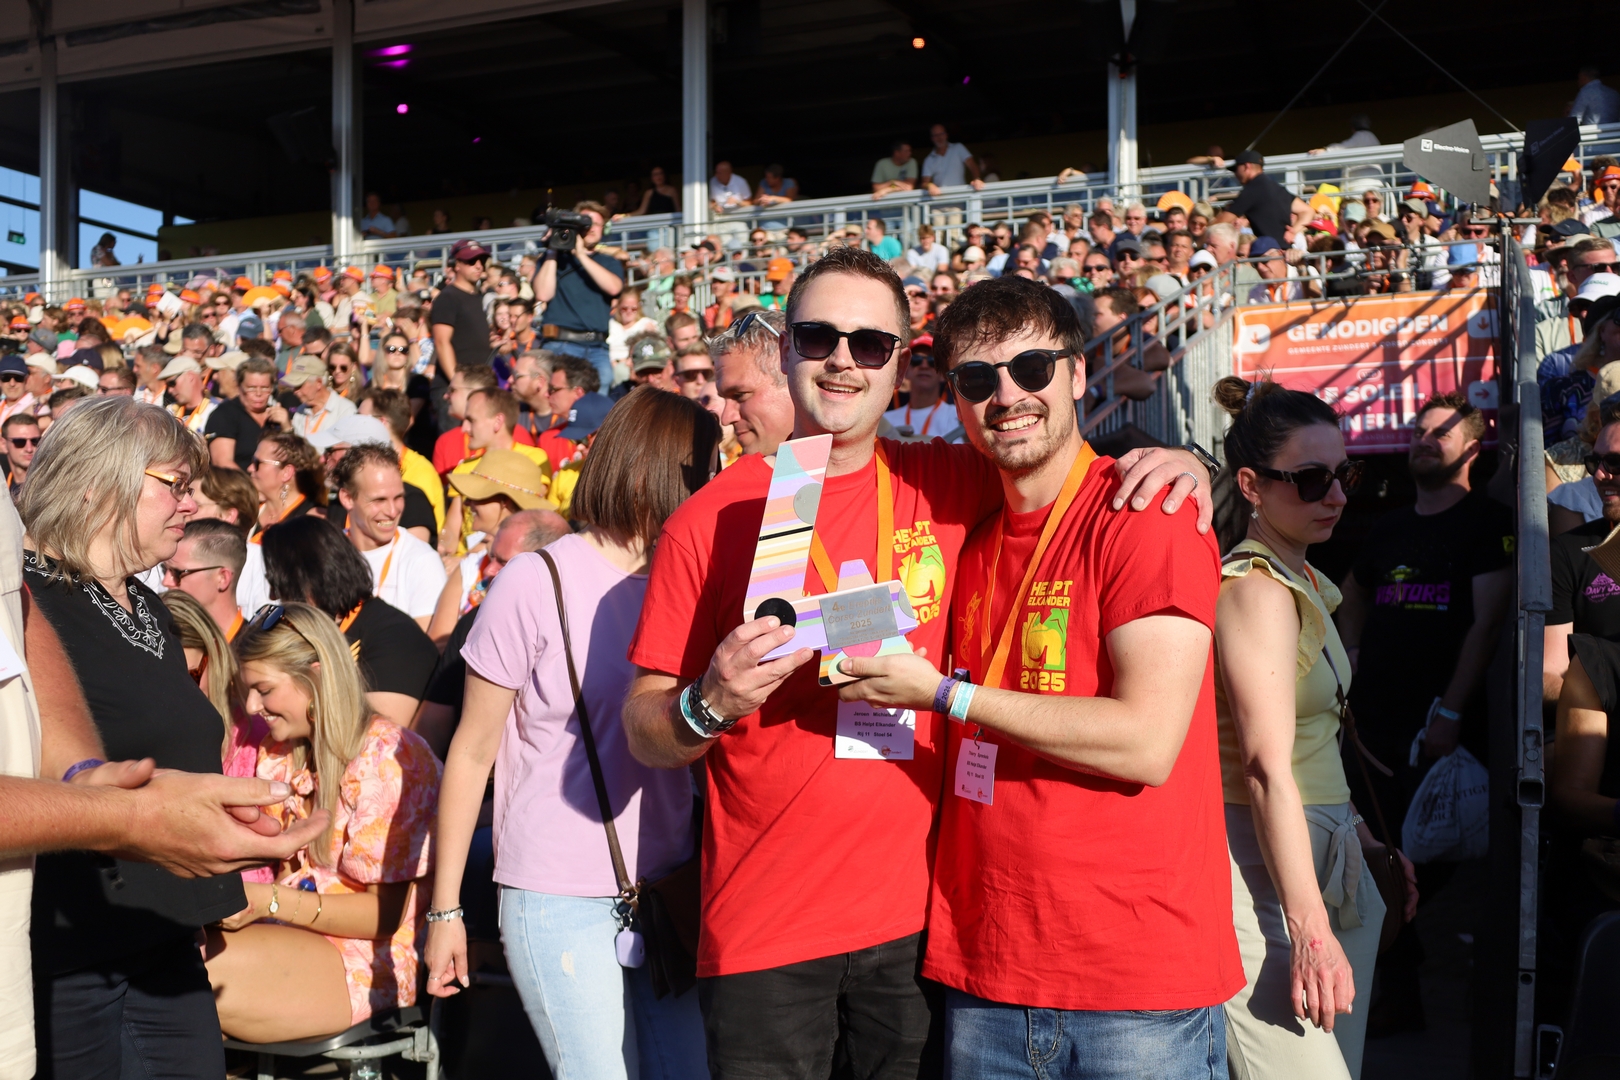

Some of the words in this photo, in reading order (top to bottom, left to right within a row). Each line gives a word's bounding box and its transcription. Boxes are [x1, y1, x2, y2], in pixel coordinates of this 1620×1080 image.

[1288, 315, 1448, 341] GENODIGDEN
[1288, 345, 1331, 355] GEMEENTE
[1332, 342, 1370, 353] ZUNDERT
[1344, 382, 1426, 403] SOLEIL
[1585, 585, 1606, 596] DAVY
[1607, 583, 1620, 593] JO
[1027, 596, 1071, 607] ELKANDER
[828, 613, 854, 624] Corso
[857, 605, 891, 618] Zundert
[850, 618, 872, 630] 2025
[1020, 670, 1066, 692] 2025
